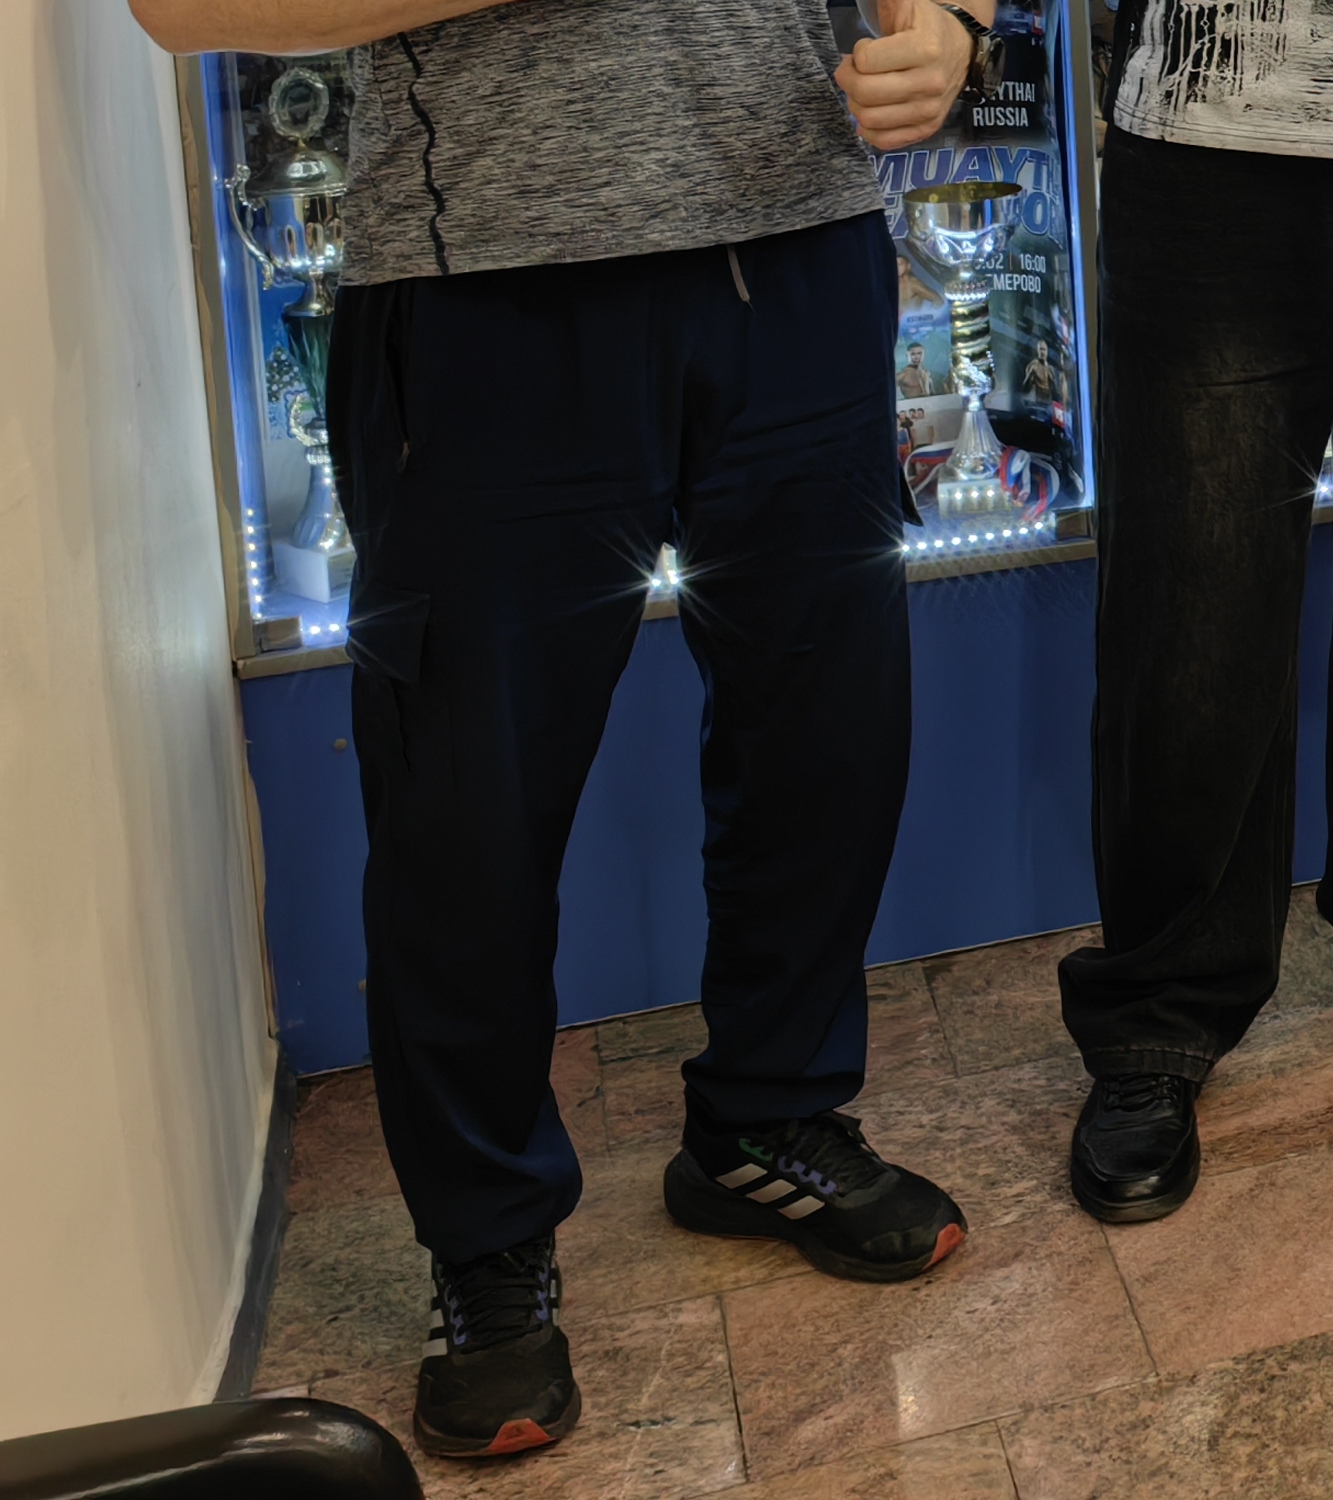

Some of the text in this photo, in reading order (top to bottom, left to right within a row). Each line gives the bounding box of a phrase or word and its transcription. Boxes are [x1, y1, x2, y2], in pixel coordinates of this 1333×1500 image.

[973, 106, 1030, 128] RUSSIA
[869, 145, 1052, 194] MUAYT
[1019, 253, 1047, 274] 16:00
[986, 273, 1042, 294] ЕМЕРОВО
